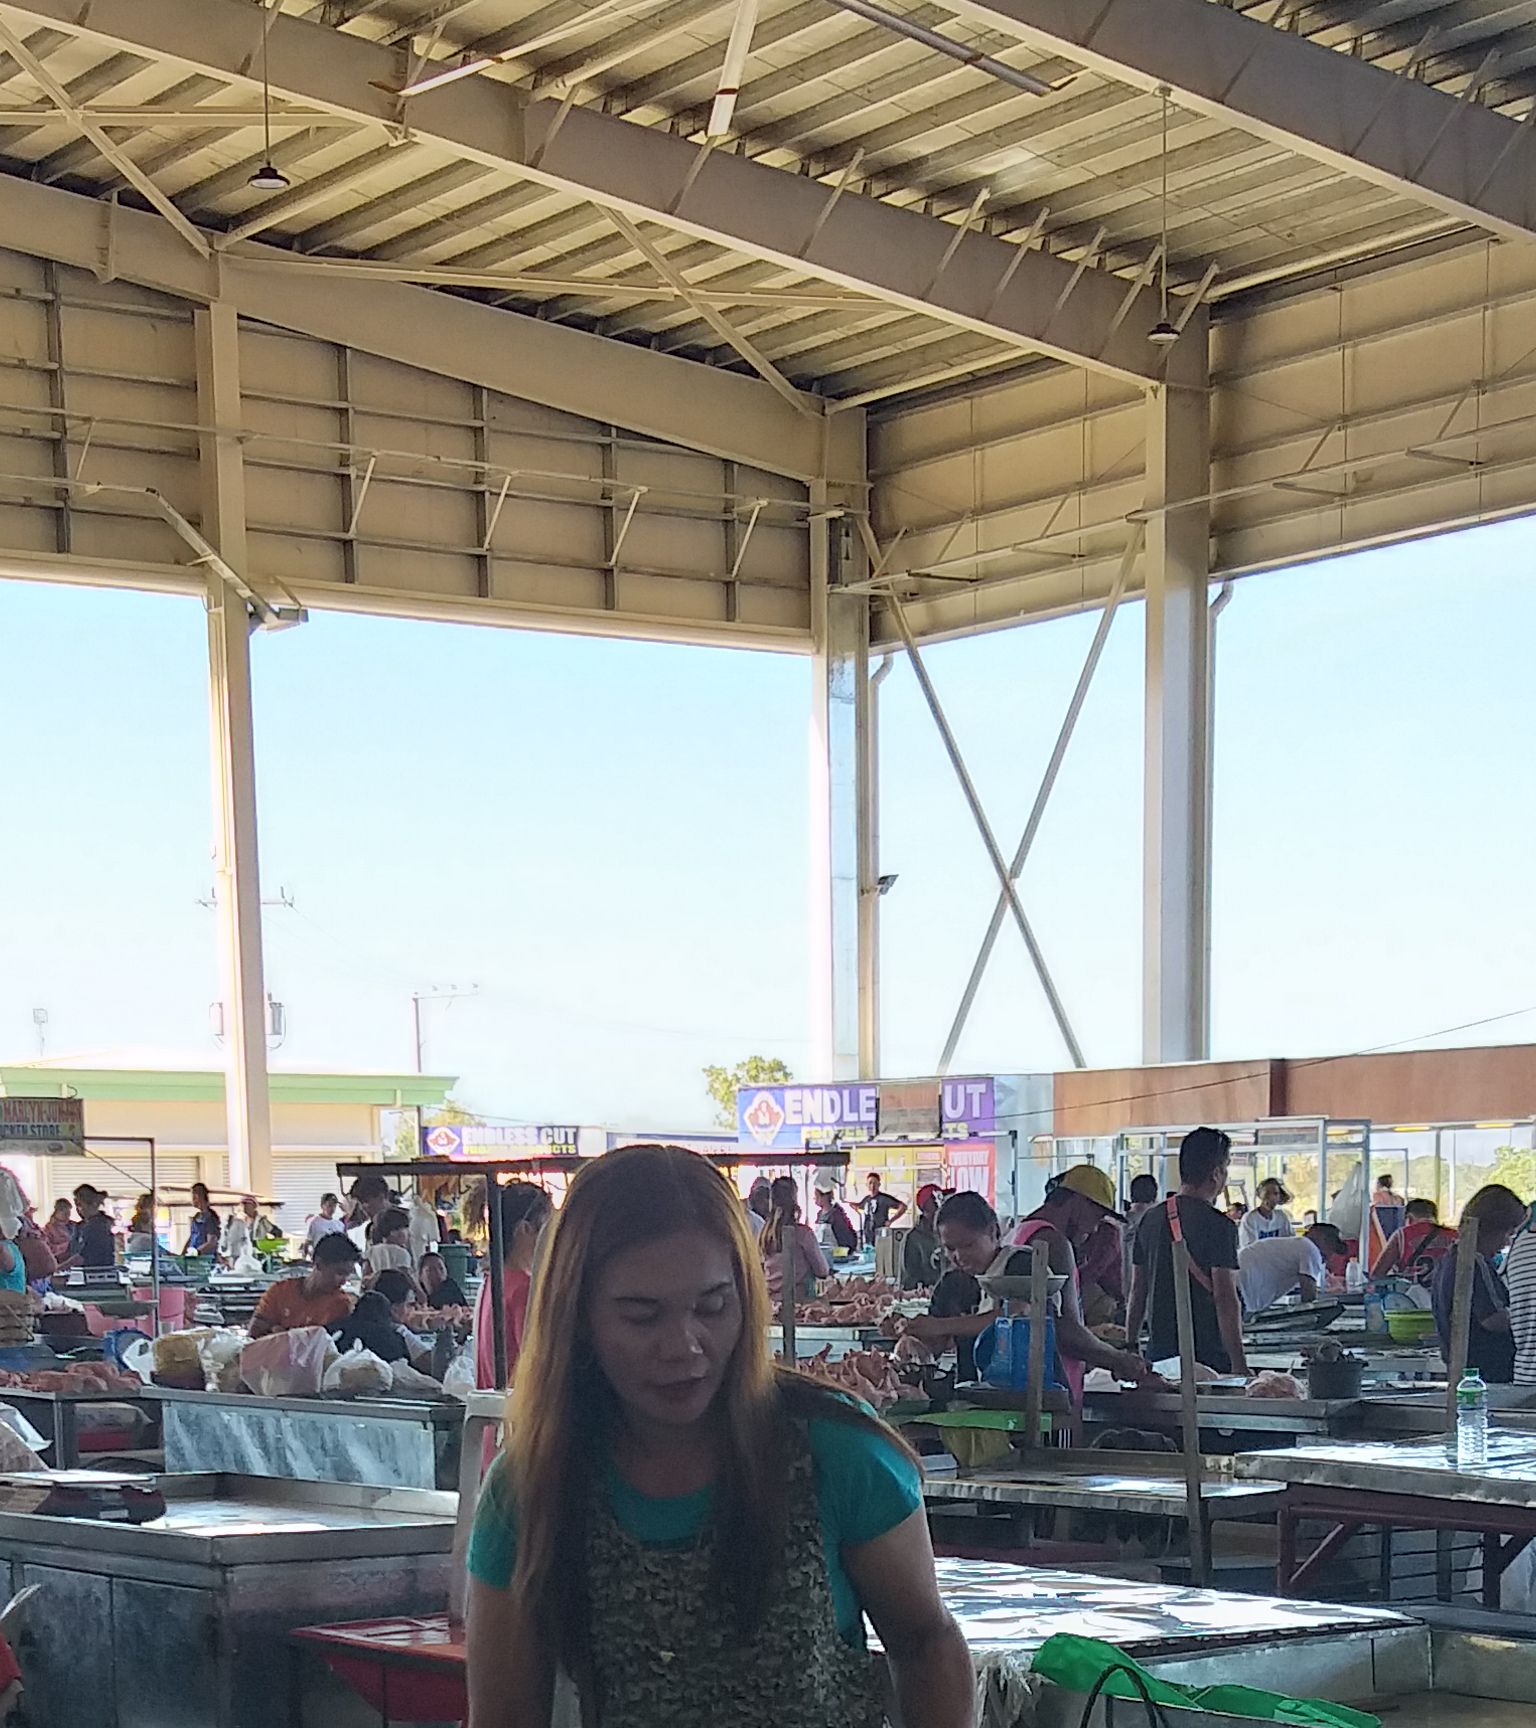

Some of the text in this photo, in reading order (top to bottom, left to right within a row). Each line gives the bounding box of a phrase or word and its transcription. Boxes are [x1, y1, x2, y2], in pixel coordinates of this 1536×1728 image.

[784, 1083, 987, 1125] ENDLE UT
[540, 1127, 577, 1145] CUT
